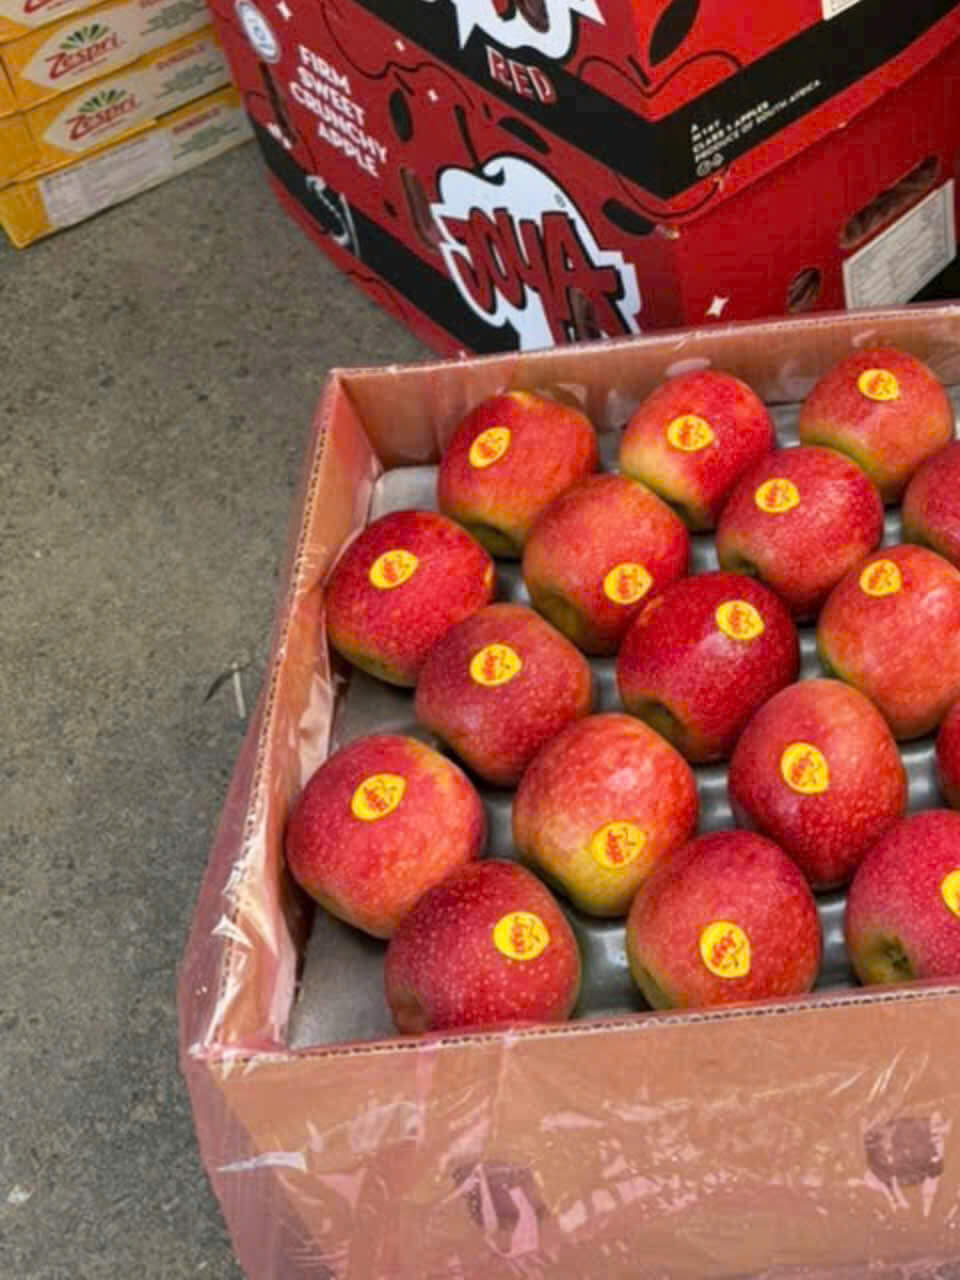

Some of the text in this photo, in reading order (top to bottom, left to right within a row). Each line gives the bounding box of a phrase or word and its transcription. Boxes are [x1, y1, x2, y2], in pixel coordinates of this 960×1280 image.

[45, 32, 120, 80] Zespri
[298, 44, 351, 95] FIRM
[485, 44, 557, 105] RED
[66, 93, 138, 141] Zespri
[289, 81, 387, 164] CRUNCHY
[297, 66, 365, 127] SWEET
[318, 121, 379, 178] APPLE
[440, 205, 633, 345] JOYA
